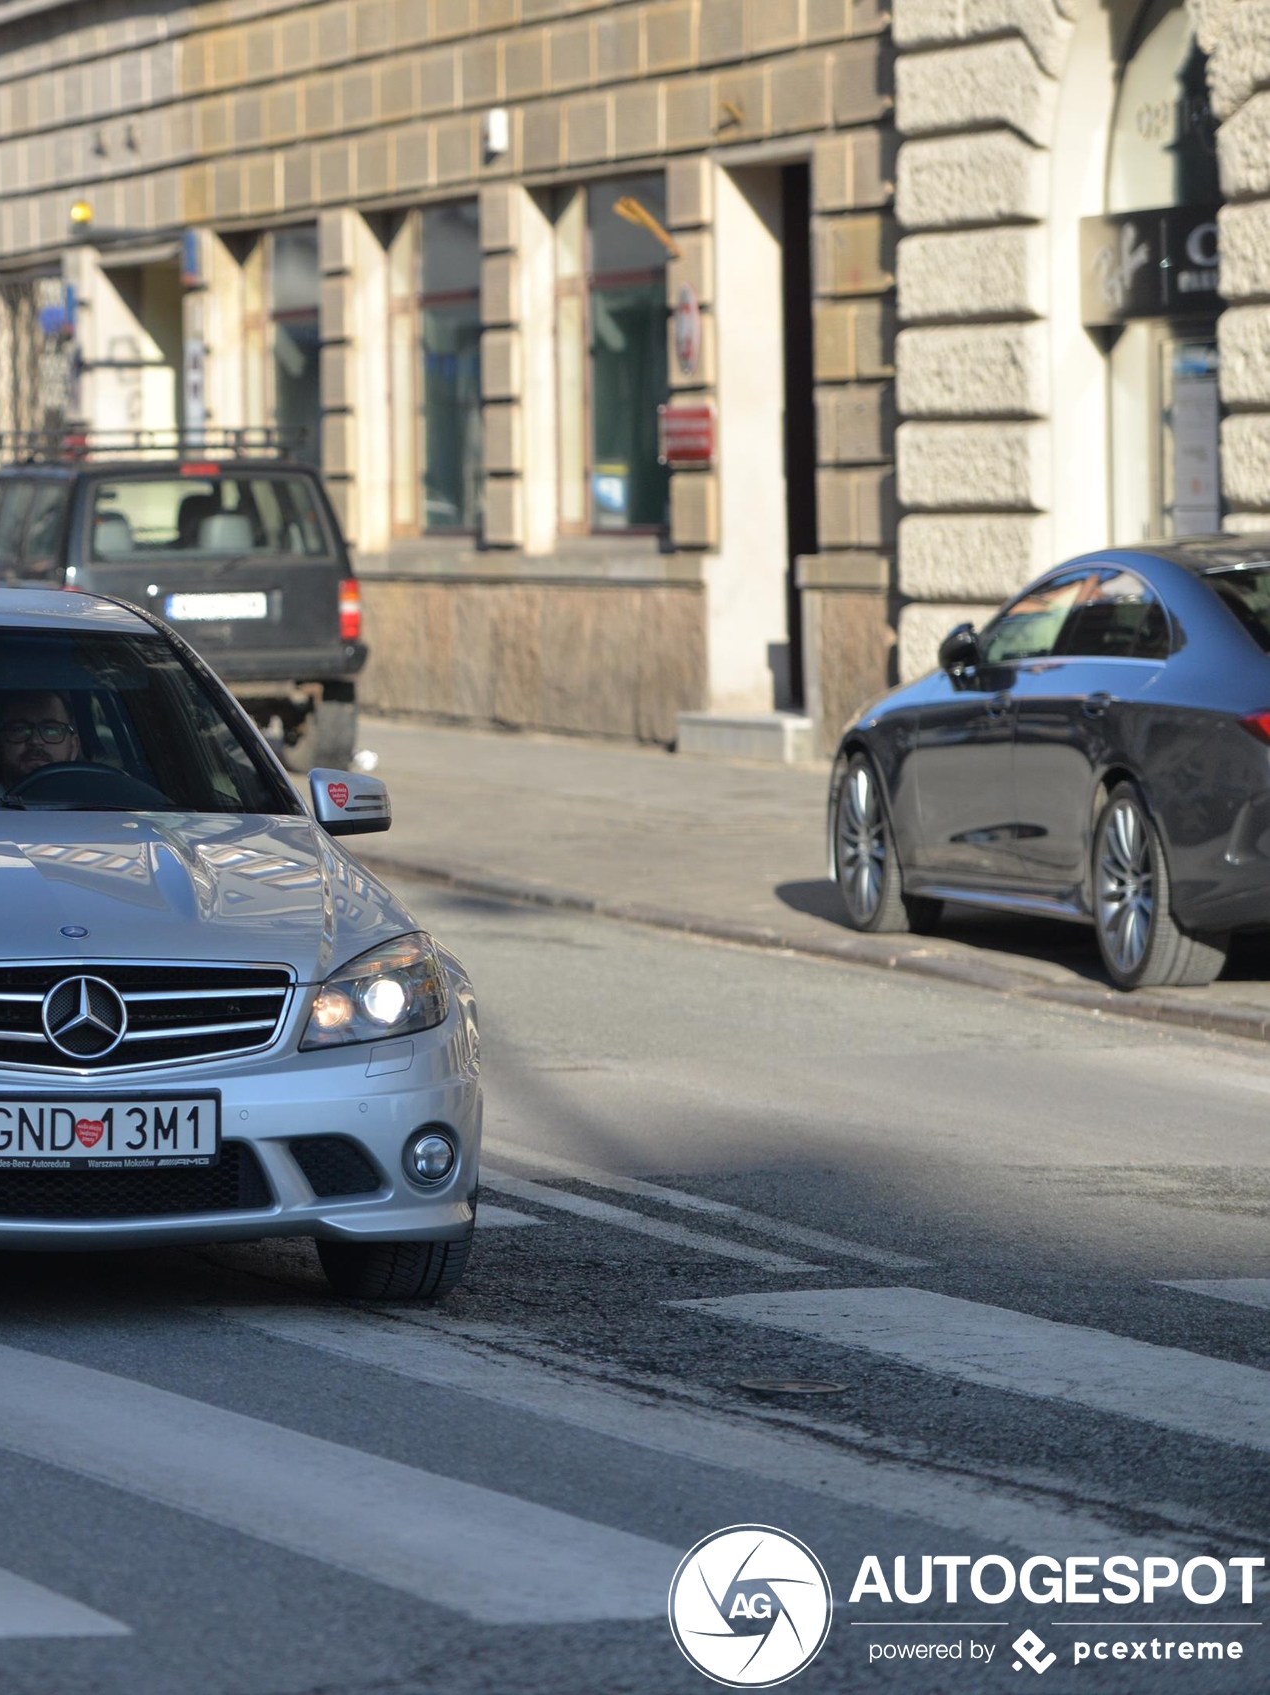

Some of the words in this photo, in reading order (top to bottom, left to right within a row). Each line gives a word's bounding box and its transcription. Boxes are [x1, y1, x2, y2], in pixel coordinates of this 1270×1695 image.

[101, 1106, 200, 1150] 13M1
[31, 1159, 71, 1169] Autoreduta
[87, 1159, 123, 1168] Warszawa
[124, 1157, 155, 1167] Mokotów
